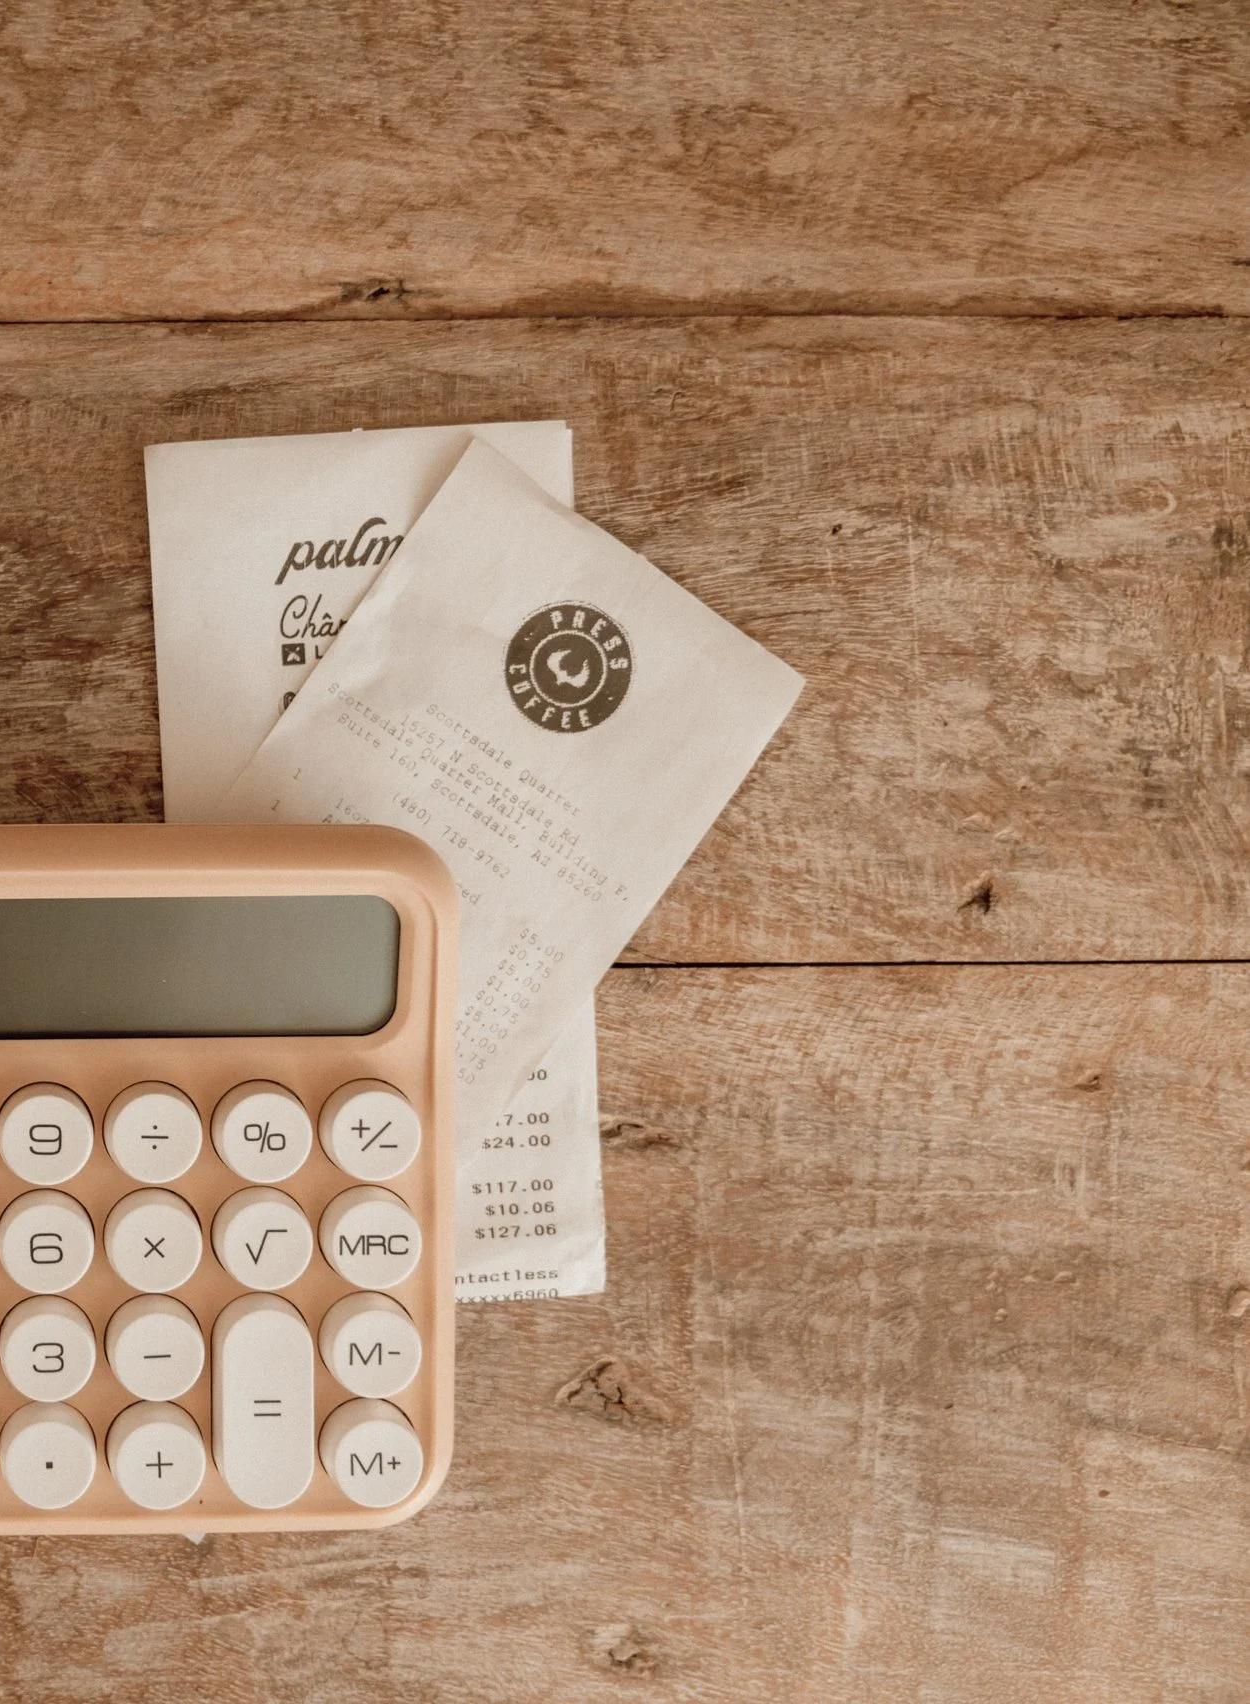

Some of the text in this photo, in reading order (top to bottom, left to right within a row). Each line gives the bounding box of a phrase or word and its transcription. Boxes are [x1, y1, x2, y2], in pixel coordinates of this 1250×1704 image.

[549, 608, 631, 672] PRESS
[507, 662, 597, 730] COFFEE
[293, 769, 301, 780] 1
[424, 702, 583, 818] Scottsdale Quarter
[325, 681, 417, 748] Scottsdale
[418, 745, 483, 796] Quarter
[485, 792, 532, 830] Mall,
[535, 829, 610, 887] Building
[399, 714, 446, 751] 15257
[465, 761, 556, 829] Scottsdale
[558, 825, 581, 846] Rd
[270, 799, 280, 811] 1
[336, 712, 603, 904] Suite 160, Scottsdale, AZ 85260
[390, 791, 512, 879] (480) 718-9762
[506, 942, 553, 980] $0.75
[517, 926, 565, 964] $5.00
[484, 973, 531, 1010] $1.00
[495, 957, 543, 995] $5.00
[462, 1004, 509, 1040] $5.00
[473, 988, 520, 1025] $0.75
[452, 1019, 498, 1055] $1.00
[29, 1124, 63, 1156] 9
[243, 1121, 286, 1153] %
[482, 1135, 551, 1149] $24.00
[472, 1179, 553, 1195] $117.00
[485, 1202, 554, 1216] $10.06
[29, 1232, 64, 1265] 6
[339, 1234, 410, 1257] MRC
[475, 1224, 556, 1239] $127.06
[455, 1269, 558, 1285] ntactless
[32, 1342, 65, 1374] 3
[349, 1342, 401, 1367] M-
[349, 1452, 401, 1476] M+
